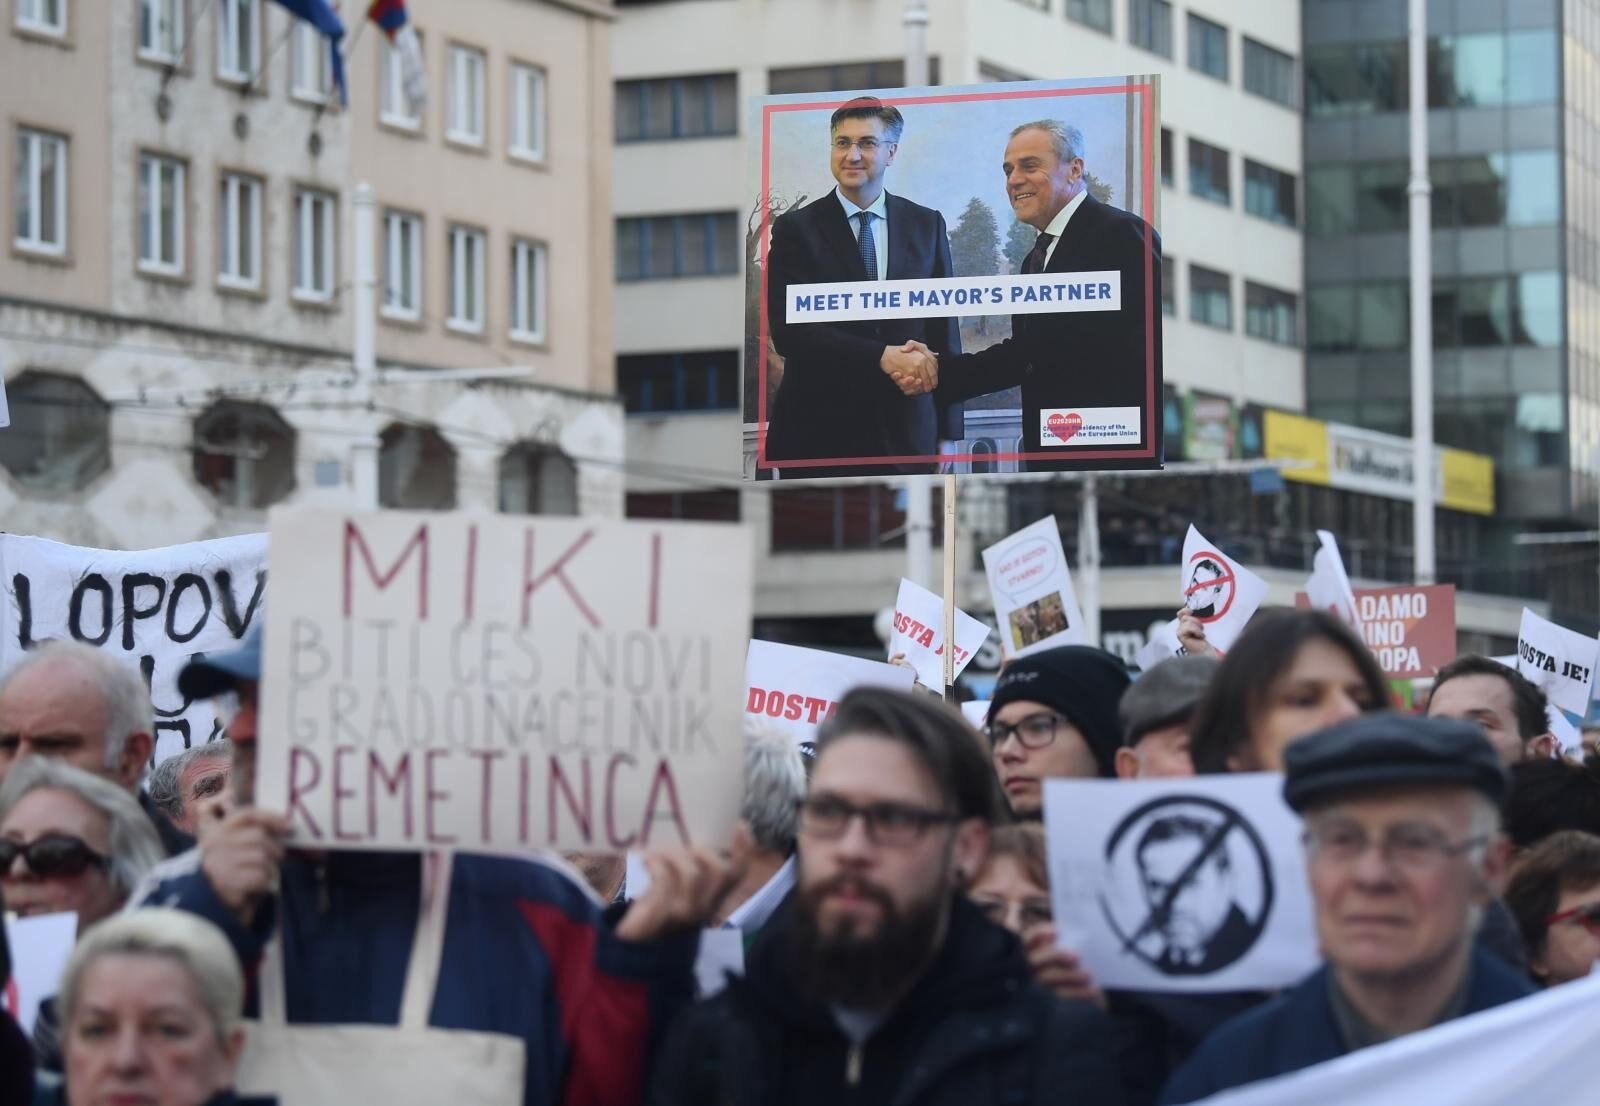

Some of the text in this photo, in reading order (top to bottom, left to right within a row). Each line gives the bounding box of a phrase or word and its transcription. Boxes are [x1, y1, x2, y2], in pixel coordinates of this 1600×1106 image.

[795, 283, 1111, 311] MEET THE MAYOR'S PARTNER
[343, 518, 662, 629] MIKI
[1361, 593, 1428, 621] DAMO
[289, 617, 422, 684] BITI
[576, 631, 712, 695] NOVI
[1375, 646, 1422, 672] OPA
[1562, 661, 1590, 684] JE!
[286, 745, 693, 849] REMETINCA
